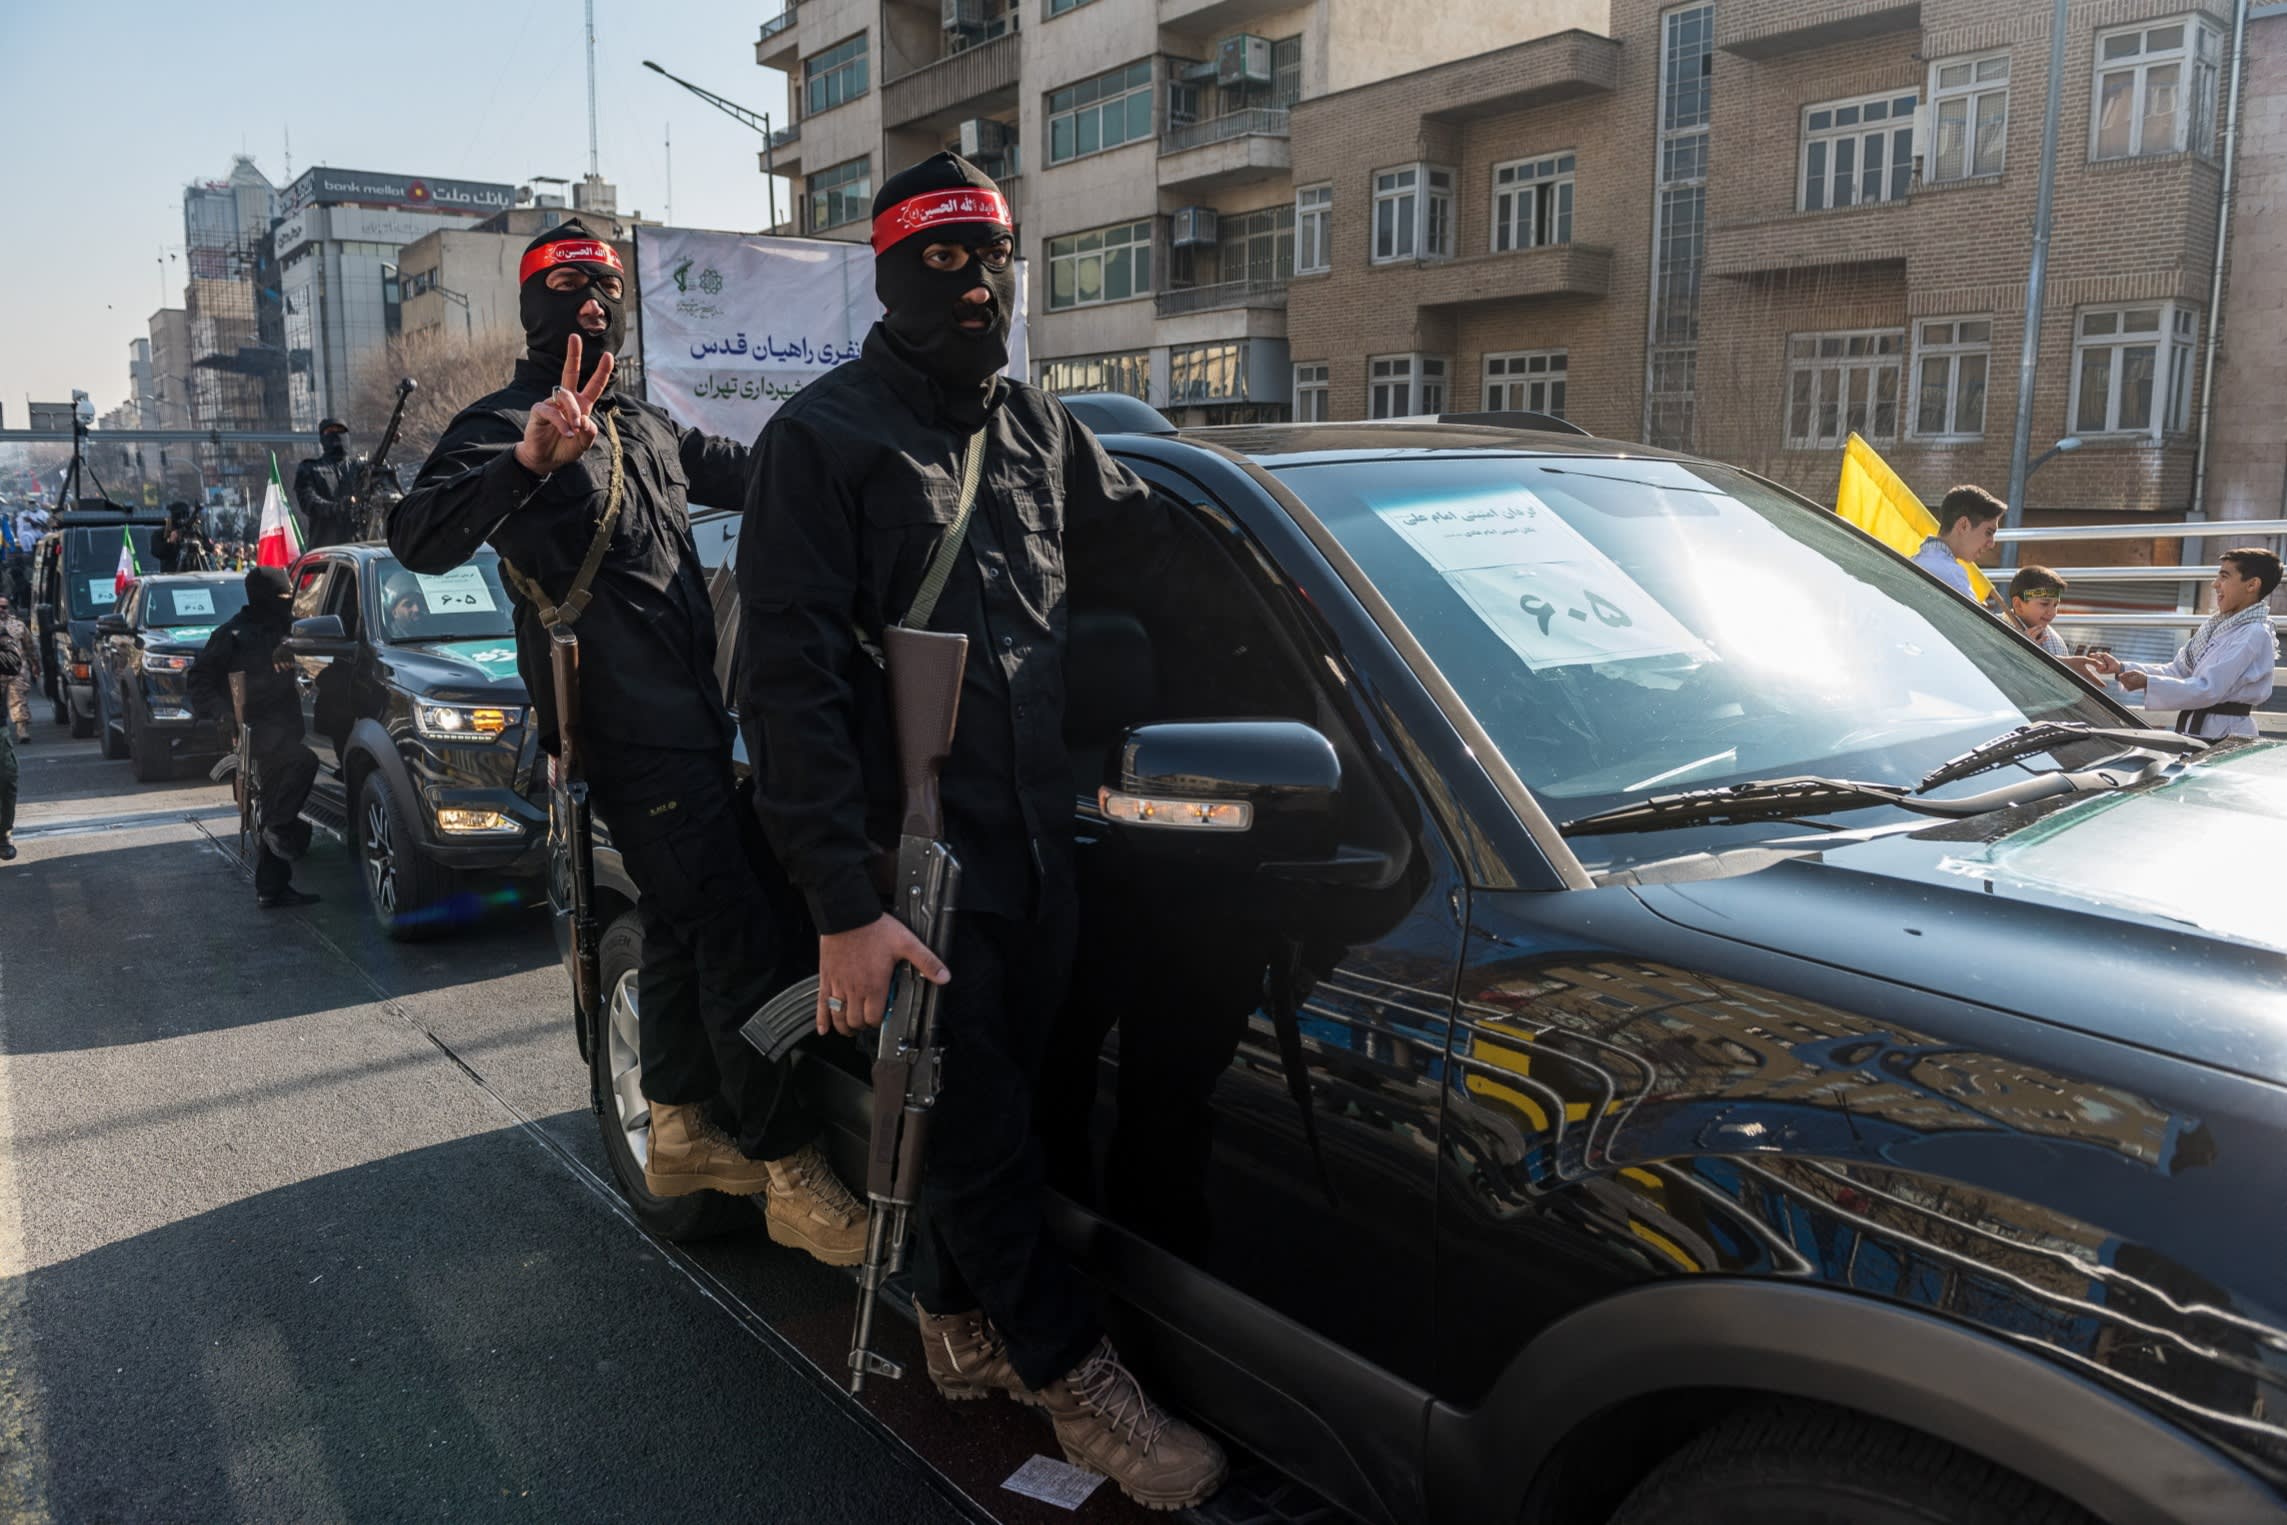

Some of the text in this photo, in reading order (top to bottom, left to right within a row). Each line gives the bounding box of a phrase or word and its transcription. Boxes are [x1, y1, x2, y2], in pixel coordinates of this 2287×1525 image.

[324, 180, 405, 197] bank mellat
[432, 187, 470, 204] ملت
[690, 332, 748, 360] قدس
[752, 335, 814, 365] راهیان
[694, 374, 738, 399] تهران
[1402, 512, 1429, 526] علی
[441, 594, 477, 606] ۶۰۵
[1519, 589, 1633, 637] ۶۰۵
